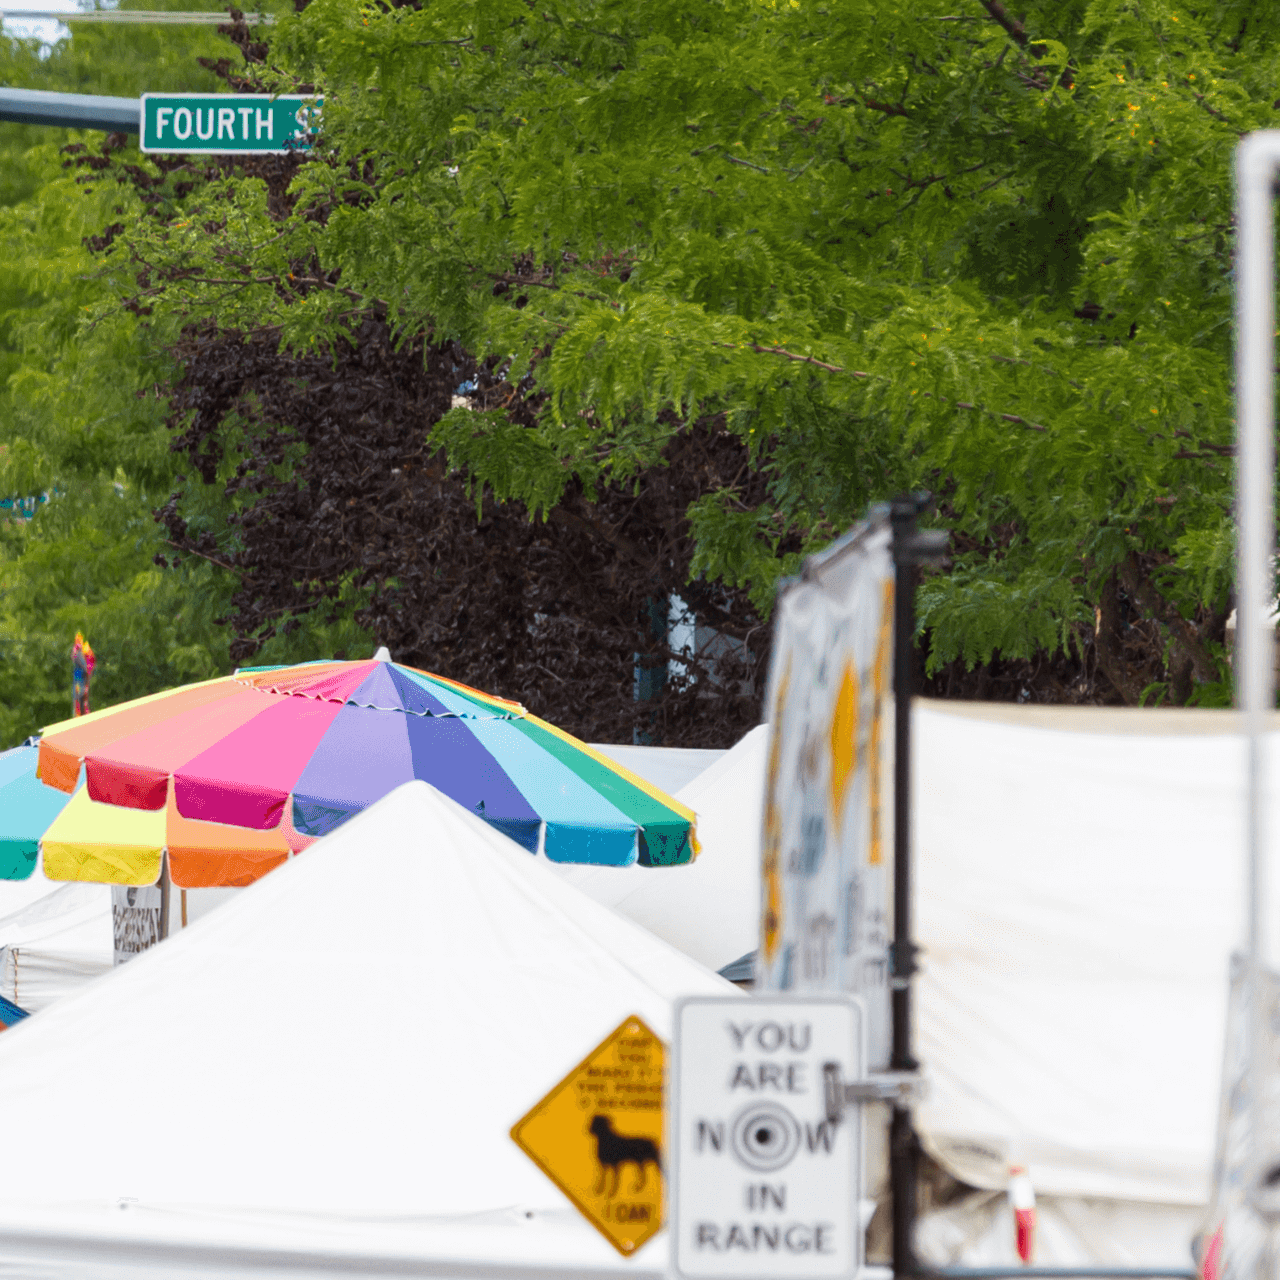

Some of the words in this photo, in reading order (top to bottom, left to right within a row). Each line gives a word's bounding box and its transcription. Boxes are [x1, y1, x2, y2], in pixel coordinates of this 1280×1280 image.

[156, 107, 274, 140] FOURTH
[727, 1022, 812, 1052] YOU
[731, 1062, 808, 1094] ARE
[748, 1185, 786, 1213] IN
[696, 1223, 834, 1255] RANGE
